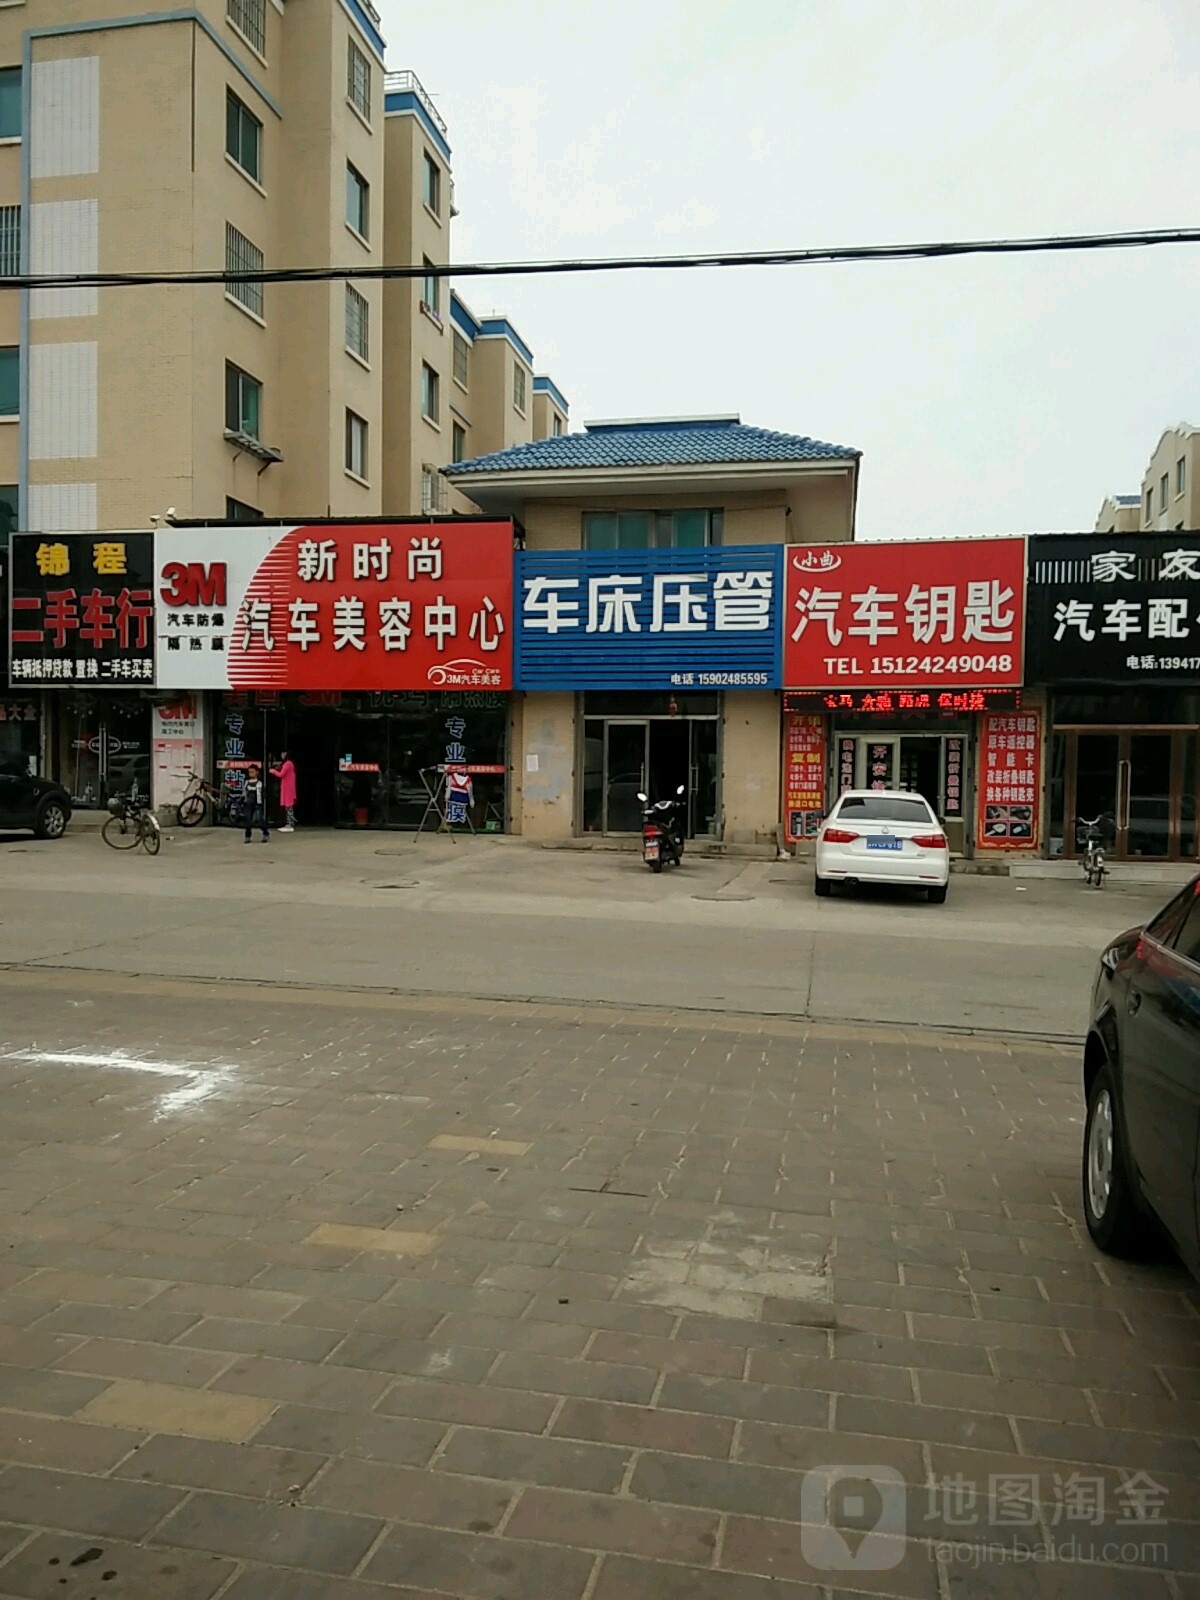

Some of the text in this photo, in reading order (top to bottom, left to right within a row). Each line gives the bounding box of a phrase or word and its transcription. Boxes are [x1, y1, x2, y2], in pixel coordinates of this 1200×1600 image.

[36, 543, 127, 575] 锦程
[297, 537, 443, 581] 新时尚
[160, 562, 227, 607] 3M
[523, 571, 773, 633] 车床压管
[11, 587, 152, 649] 二手车行
[167, 613, 224, 627] 汽车防爆
[240, 595, 505, 651] 汽车美容中心
[791, 579, 1015, 646] 汽车钥匙
[1053, 599, 1200, 642] 汽车配
[168, 637, 224, 651] 隔热膜
[824, 654, 1012, 675] TEL 15124249048
[12, 658, 152, 679] 车辆抵押贷款 置换 二手车买卖
[671, 673, 768, 685] 电话 15902485595
[445, 716, 467, 823] 专业膜
